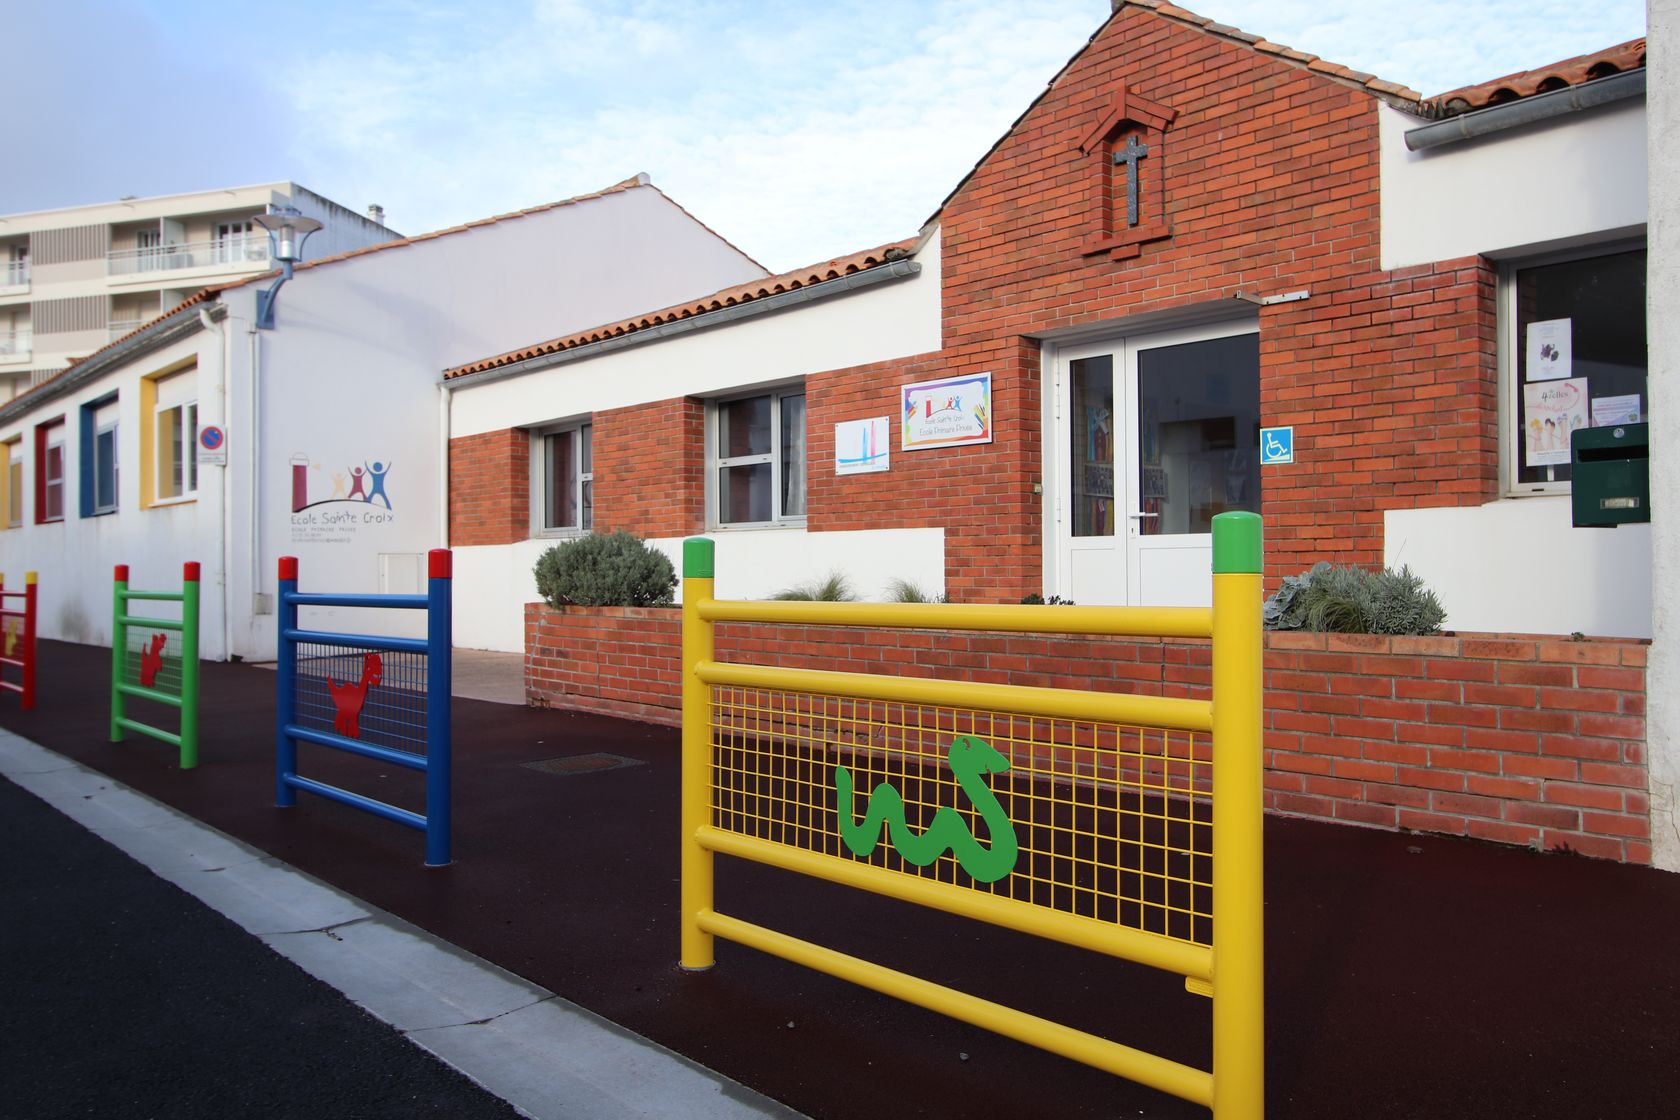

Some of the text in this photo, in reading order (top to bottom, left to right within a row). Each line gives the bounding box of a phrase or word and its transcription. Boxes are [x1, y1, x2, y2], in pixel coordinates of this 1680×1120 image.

[291, 510, 394, 525] Ecole Sainte Croix
